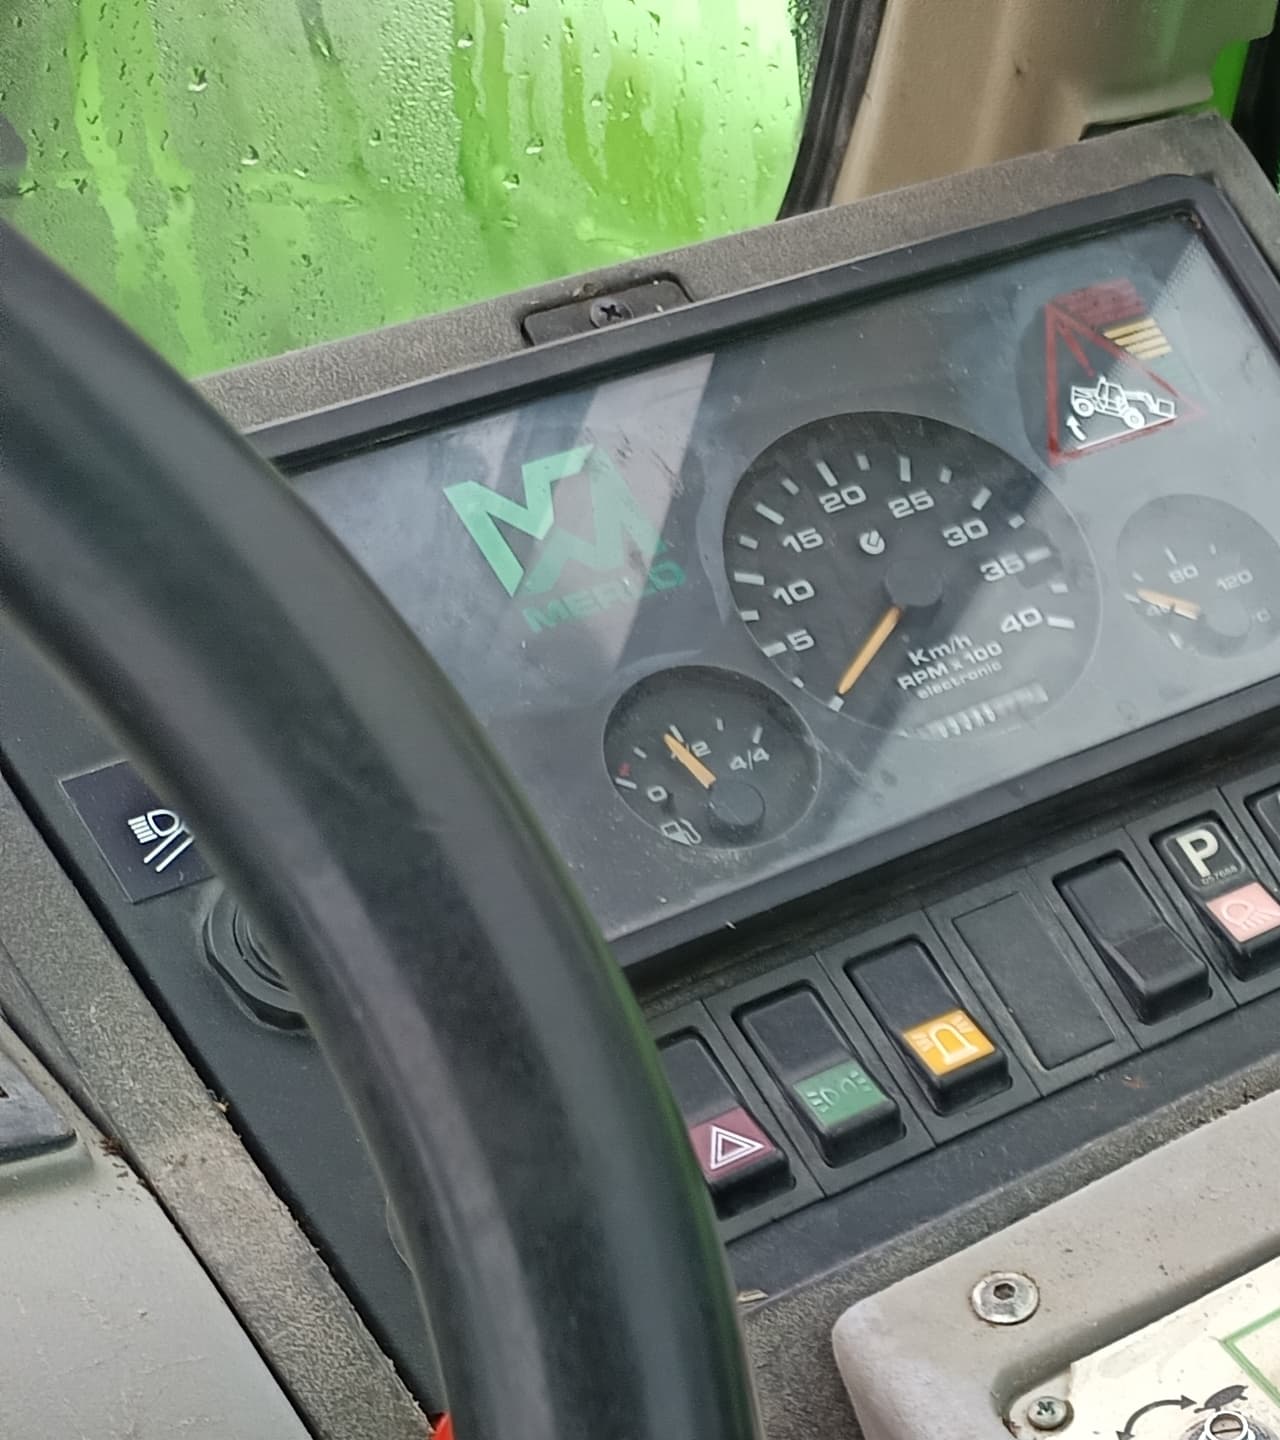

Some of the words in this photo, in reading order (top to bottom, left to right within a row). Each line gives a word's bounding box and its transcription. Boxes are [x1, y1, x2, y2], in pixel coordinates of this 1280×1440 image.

[819, 485, 867, 513] 20
[888, 490, 935, 519] 25
[782, 527, 824, 552] 15
[943, 518, 989, 547] 30
[980, 553, 1026, 582] 35
[1216, 569, 1254, 592] 120
[773, 579, 815, 605] 10
[1000, 607, 1044, 634] 40
[786, 629, 815, 652] 5
[907, 633, 973, 666] Km/h
[897, 661, 950, 690] RPM
[963, 641, 1003, 664] 100
[916, 661, 1003, 699] electronic
[729, 747, 771, 771] 4/4
[1176, 829, 1219, 877] P
